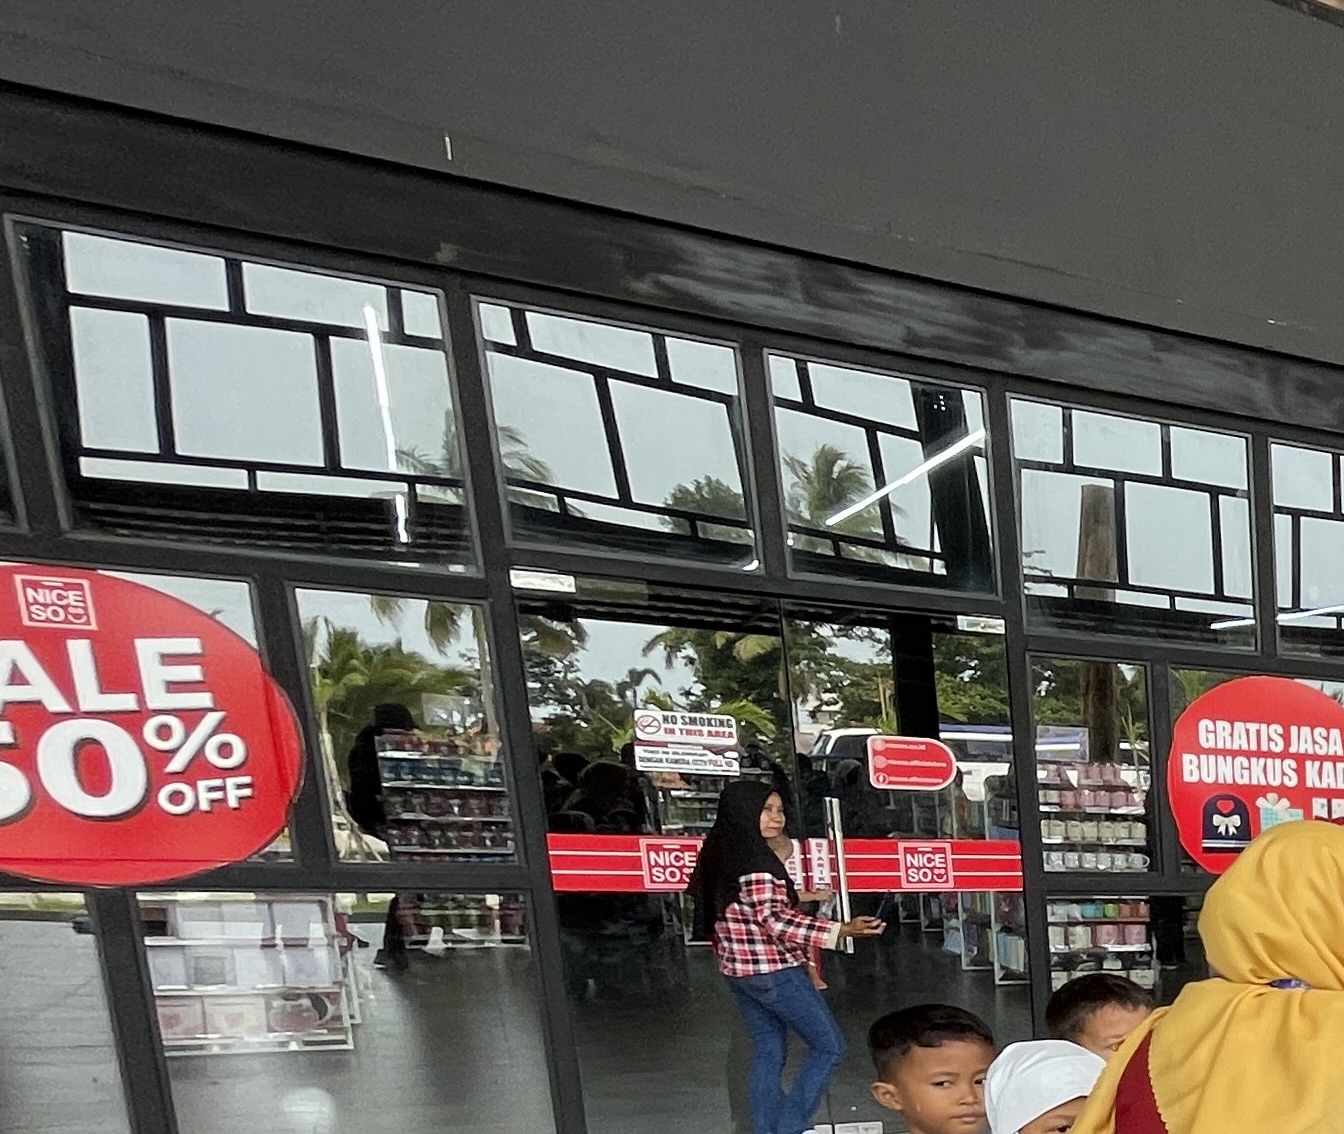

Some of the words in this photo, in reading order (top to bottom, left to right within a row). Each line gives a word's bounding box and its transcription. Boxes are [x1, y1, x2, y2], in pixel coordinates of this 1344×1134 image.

[26, 588, 86, 606] NICE
[31, 605, 65, 622] SO
[0, 637, 214, 713] ALE
[662, 714, 678, 725] NO
[681, 715, 734, 728] SMOKING
[1198, 719, 1285, 753] GRATIS
[1289, 725, 1344, 756] JASA
[1182, 753, 1298, 787] BUNGKUS
[158, 776, 254, 815] OFF
[649, 851, 697, 867] NICE
[906, 853, 947, 868] NICE
[652, 867, 681, 882] SO
[908, 868, 932, 883] SO
